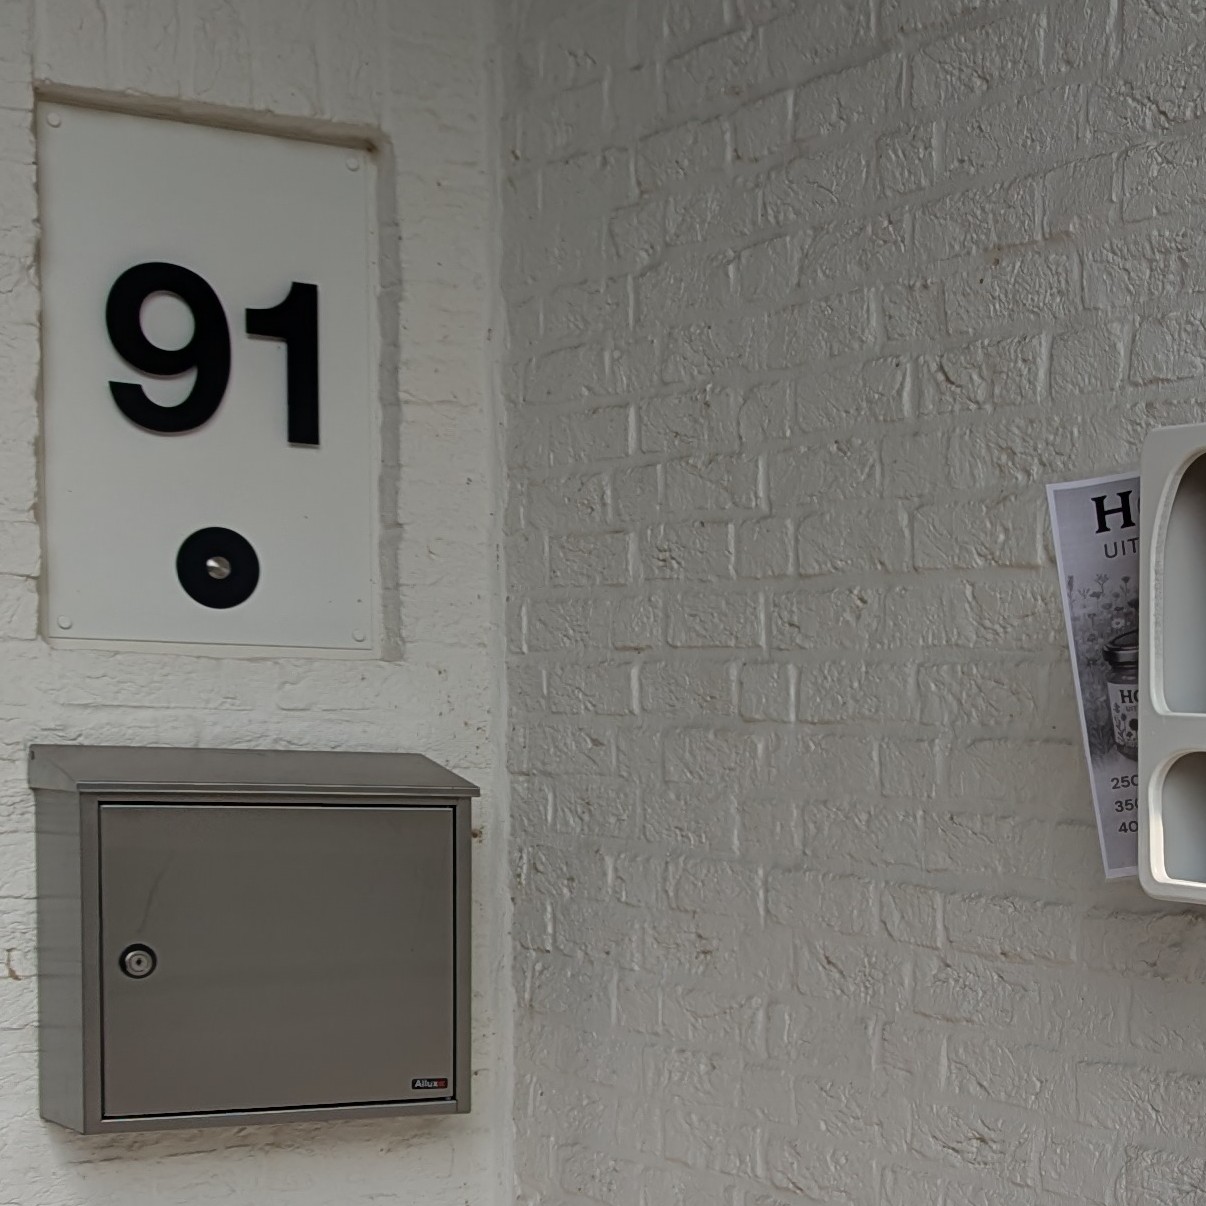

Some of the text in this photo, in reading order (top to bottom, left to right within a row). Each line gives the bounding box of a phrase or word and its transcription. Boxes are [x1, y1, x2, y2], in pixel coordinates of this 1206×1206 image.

[105, 261, 320, 446] 91
[1090, 490, 1140, 534] H
[1104, 537, 1139, 558] UIT
[1114, 798, 1138, 812] 35
